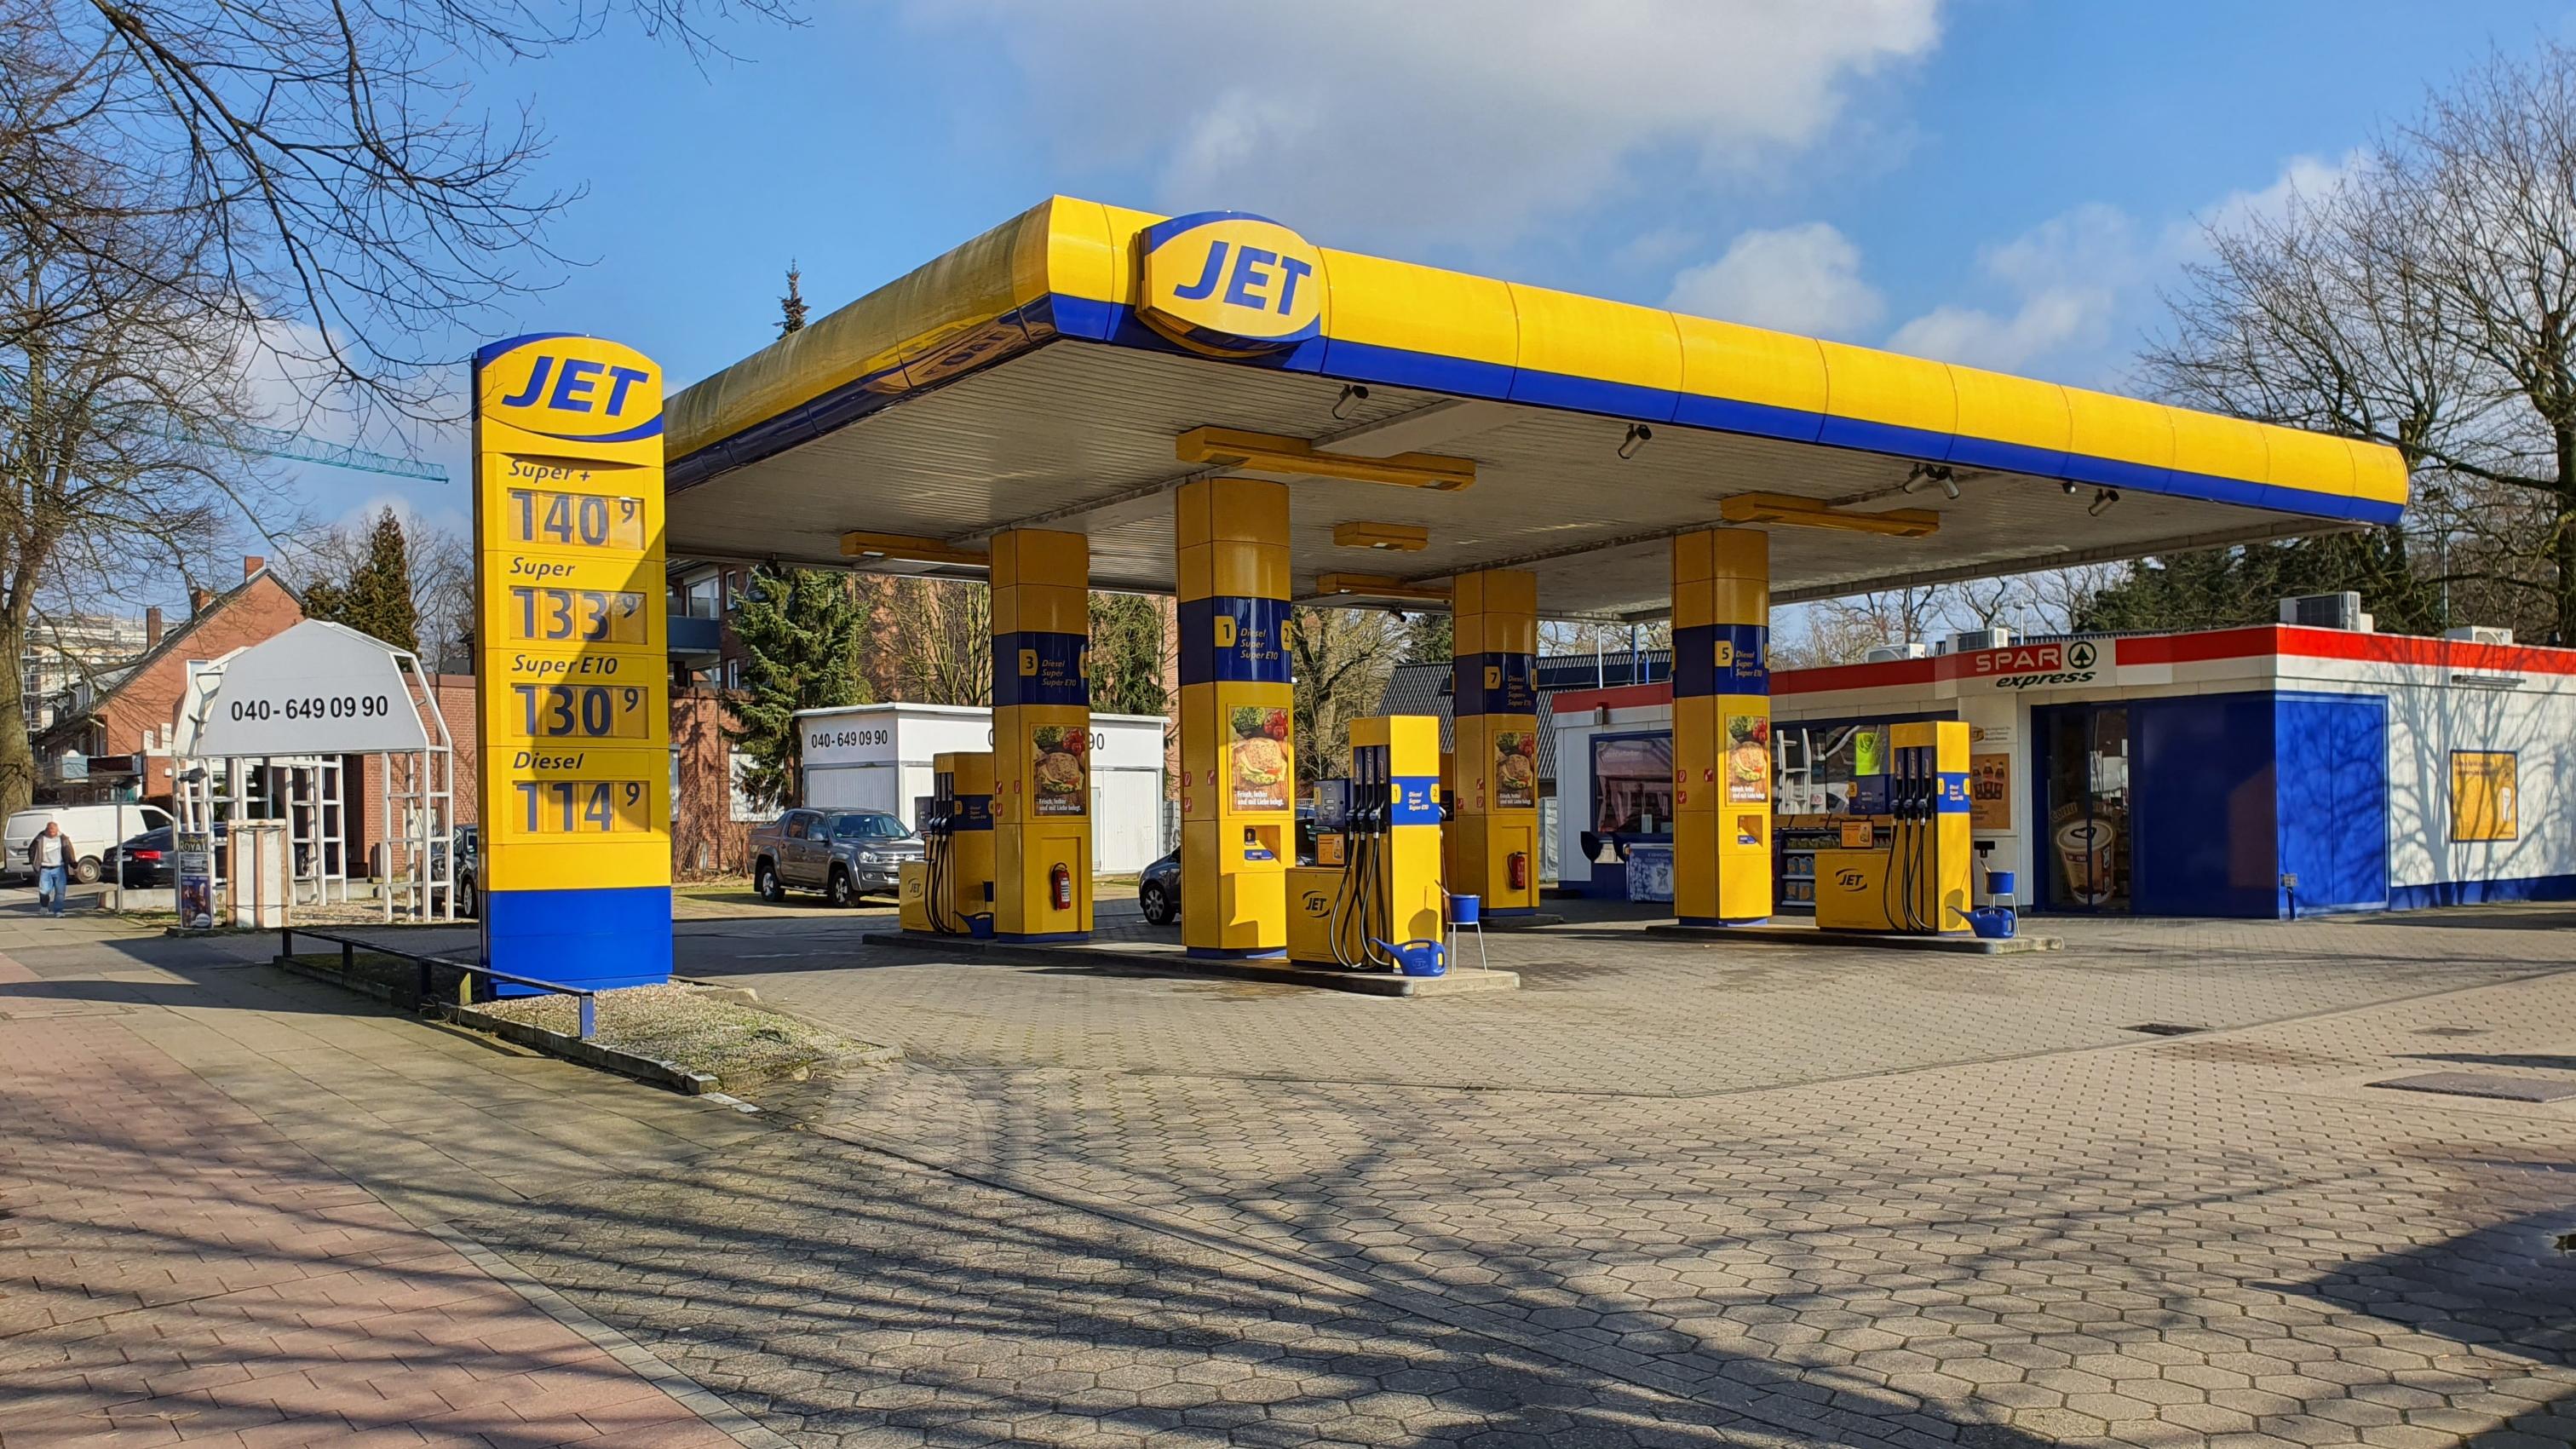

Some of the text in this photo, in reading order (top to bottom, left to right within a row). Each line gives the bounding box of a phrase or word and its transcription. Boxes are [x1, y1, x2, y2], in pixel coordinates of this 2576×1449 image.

[1173, 239, 1312, 316] JET
[501, 355, 649, 417] JET
[509, 459, 573, 483] Super
[509, 556, 576, 581] Super
[1223, 624, 1229, 639] 1
[1240, 639, 1264, 649] Super
[1240, 650, 1265, 661] Super
[1722, 647, 1729, 660] 5
[1975, 648, 2059, 672] SPAR
[512, 654, 618, 677] Super E10
[1026, 656, 1033, 670] 3
[1042, 669, 1063, 678] Super
[1491, 672, 1498, 684] 7
[1996, 671, 2096, 689] express
[1042, 678, 1064, 687] Super
[285, 698, 325, 719] 649
[330, 697, 356, 717] 09
[362, 695, 388, 716] 90
[837, 732, 857, 747] 649
[859, 730, 871, 745] 09
[874, 730, 888, 745] 90
[513, 751, 584, 770] Diesel
[179, 841, 208, 853] ROYAL
[1839, 874, 1864, 886] JET
[910, 883, 921, 894] JET
[1306, 897, 1327, 911] JET
